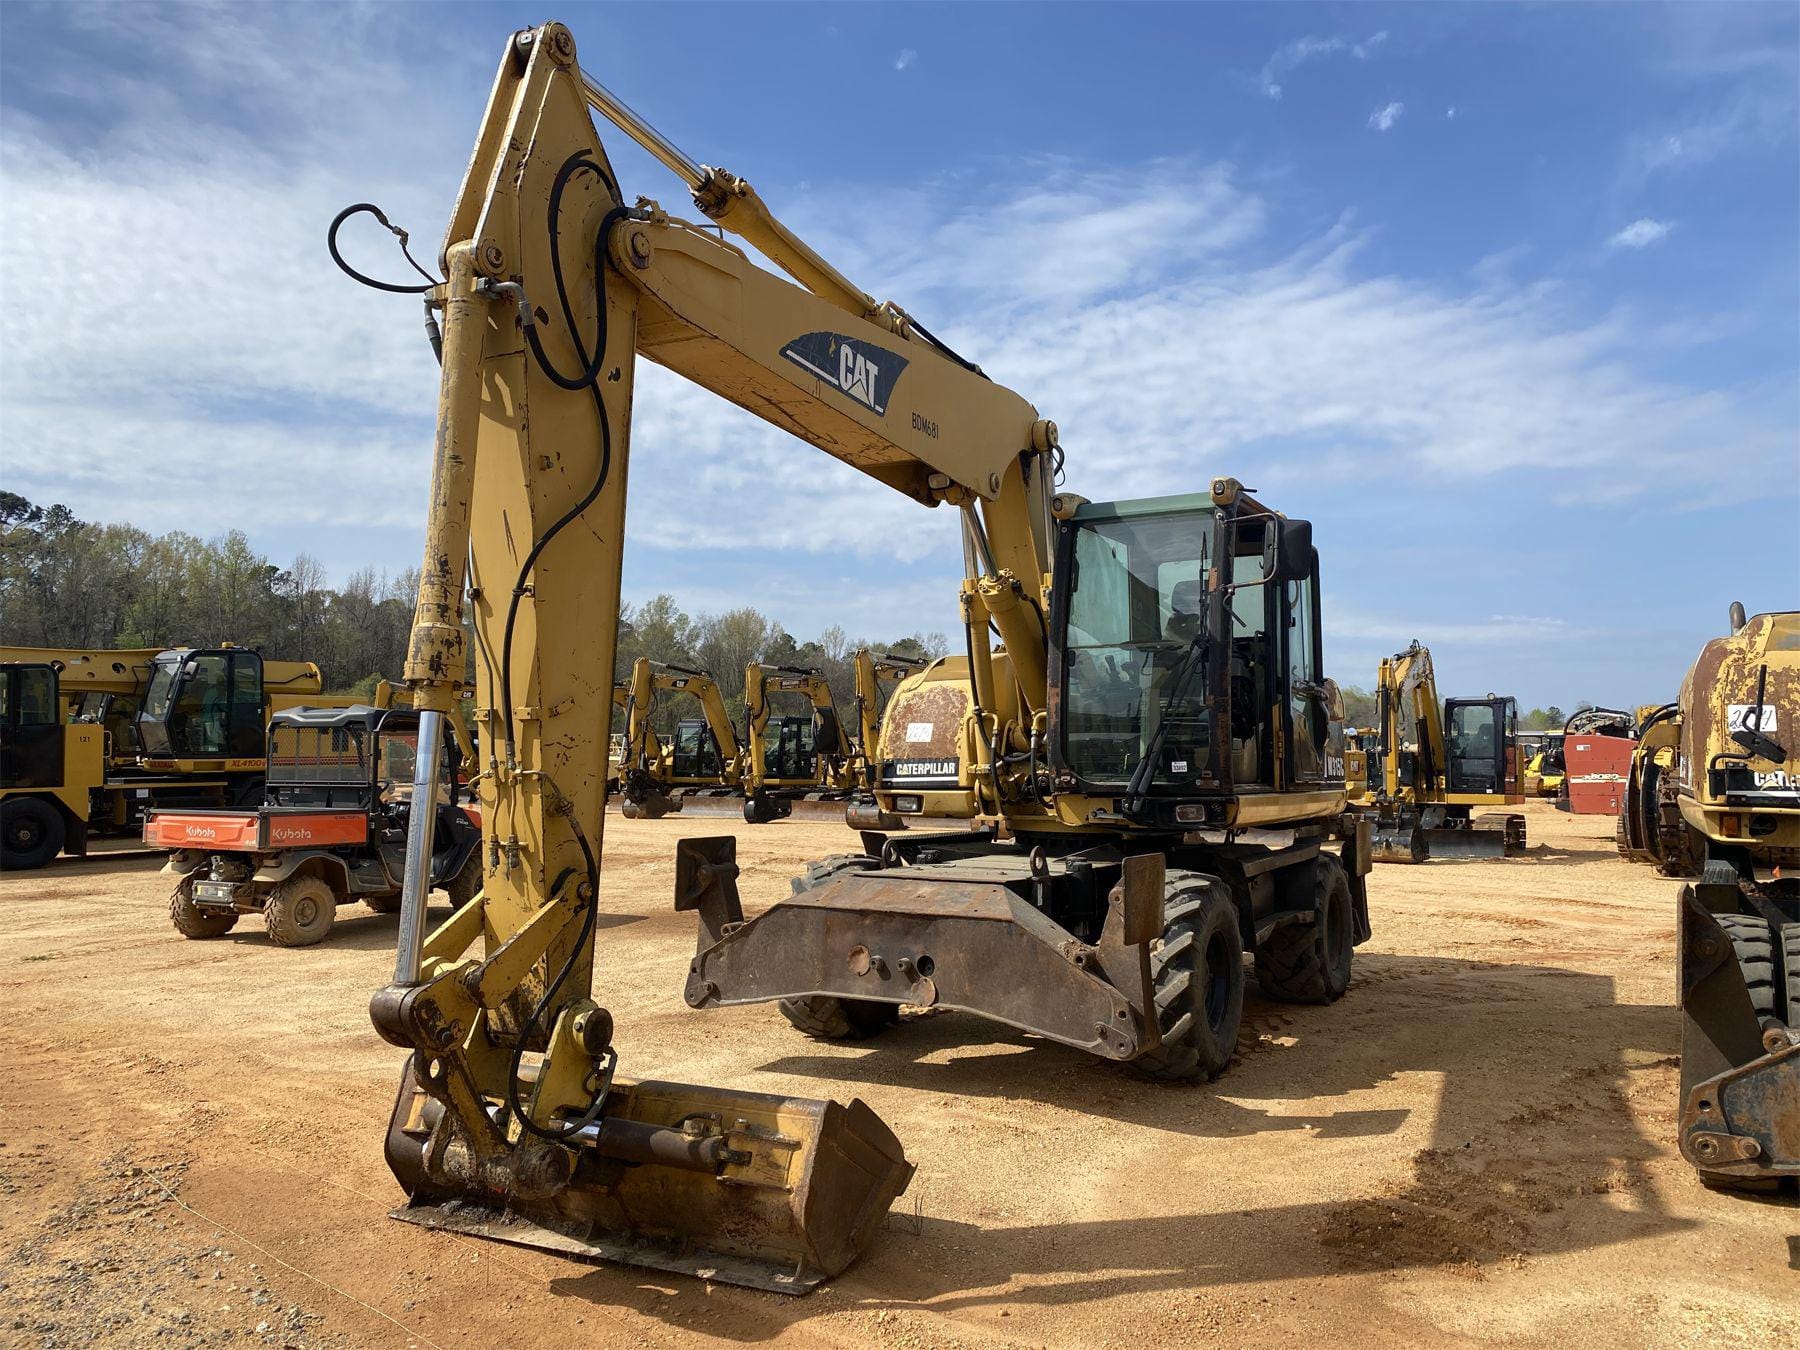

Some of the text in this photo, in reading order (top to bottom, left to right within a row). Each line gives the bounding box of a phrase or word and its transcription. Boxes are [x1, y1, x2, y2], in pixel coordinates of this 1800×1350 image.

[840, 344, 878, 408] CAT
[912, 412, 939, 440] BDM681
[896, 762, 955, 775] CATERPILLAR
[186, 825, 216, 838] Kubota
[272, 828, 312, 840] Kubota
